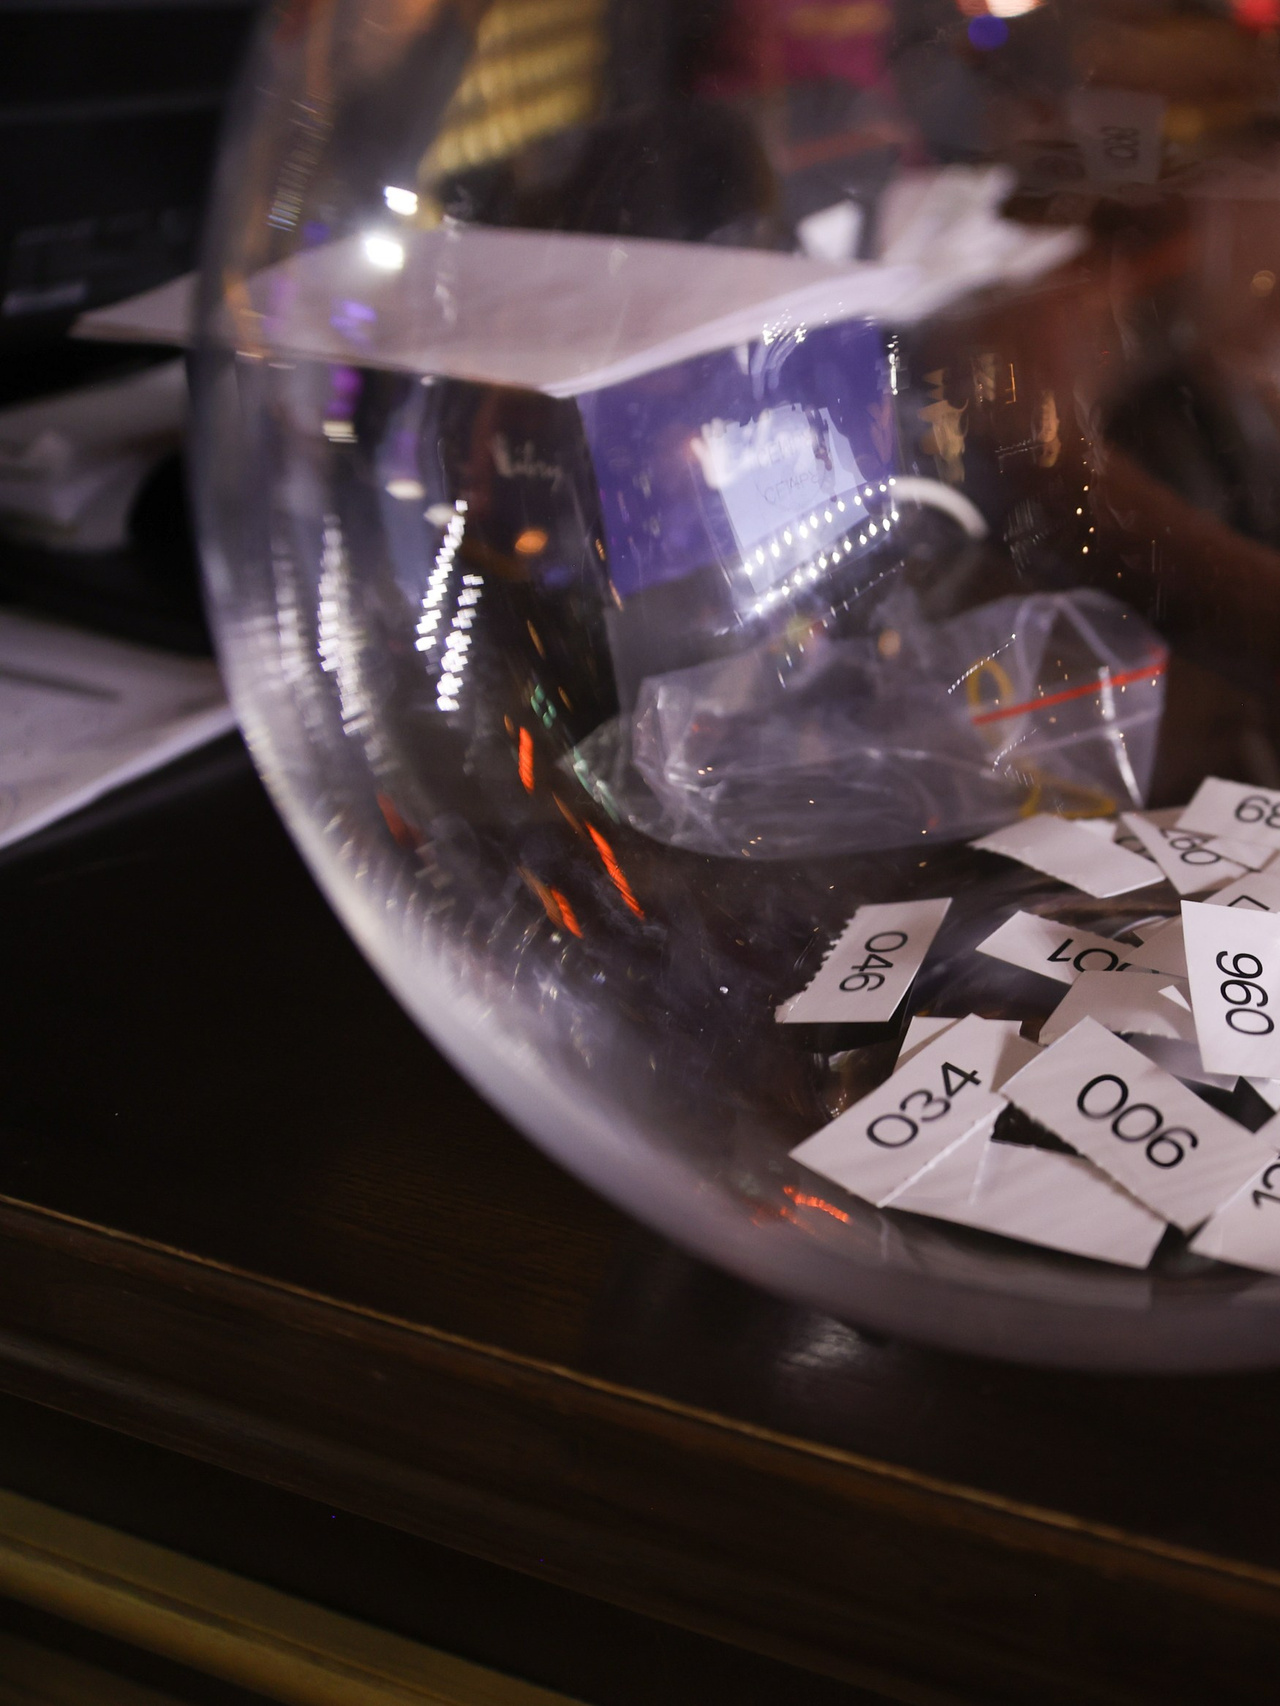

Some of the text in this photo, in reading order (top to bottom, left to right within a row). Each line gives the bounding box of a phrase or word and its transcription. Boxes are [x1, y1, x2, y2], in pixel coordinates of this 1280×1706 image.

[838, 930, 909, 993] 046
[1215, 950, 1275, 1036] 096
[866, 1061, 983, 1149] 034
[1076, 1073, 1199, 1170] 006
